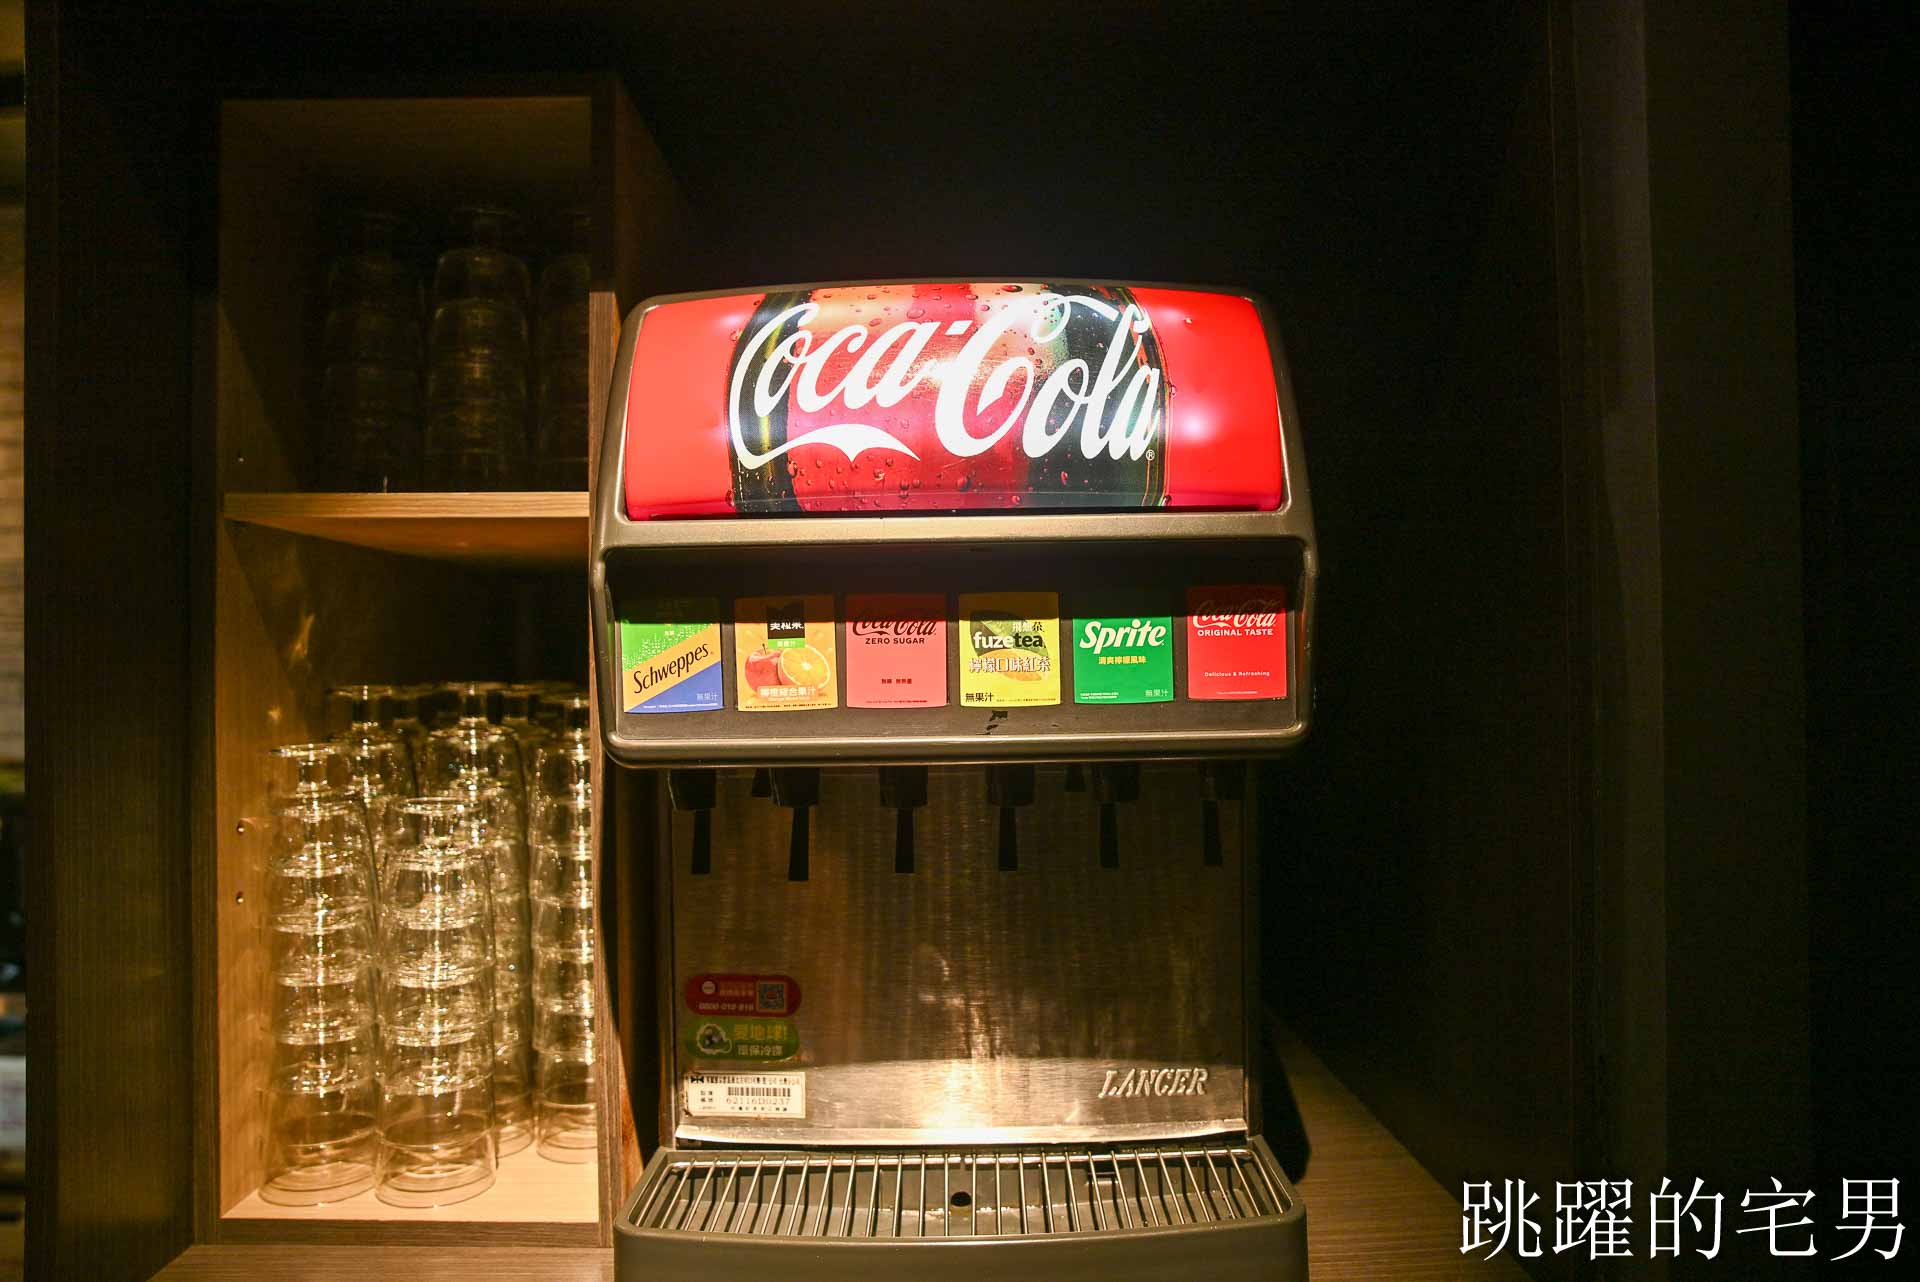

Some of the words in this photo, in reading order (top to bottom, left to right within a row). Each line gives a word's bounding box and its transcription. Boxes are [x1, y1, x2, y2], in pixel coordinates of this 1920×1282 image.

[729, 292, 1162, 470] Coca-Cola
[853, 615, 936, 635] CocaCola
[1192, 604, 1279, 628] CocaCola
[1079, 618, 1167, 655] Sprite
[1244, 628, 1274, 636] TASTE
[633, 643, 709, 694] Schweppes
[965, 692, 994, 703] 無果汁
[1098, 1067, 1208, 1098] LANCER
